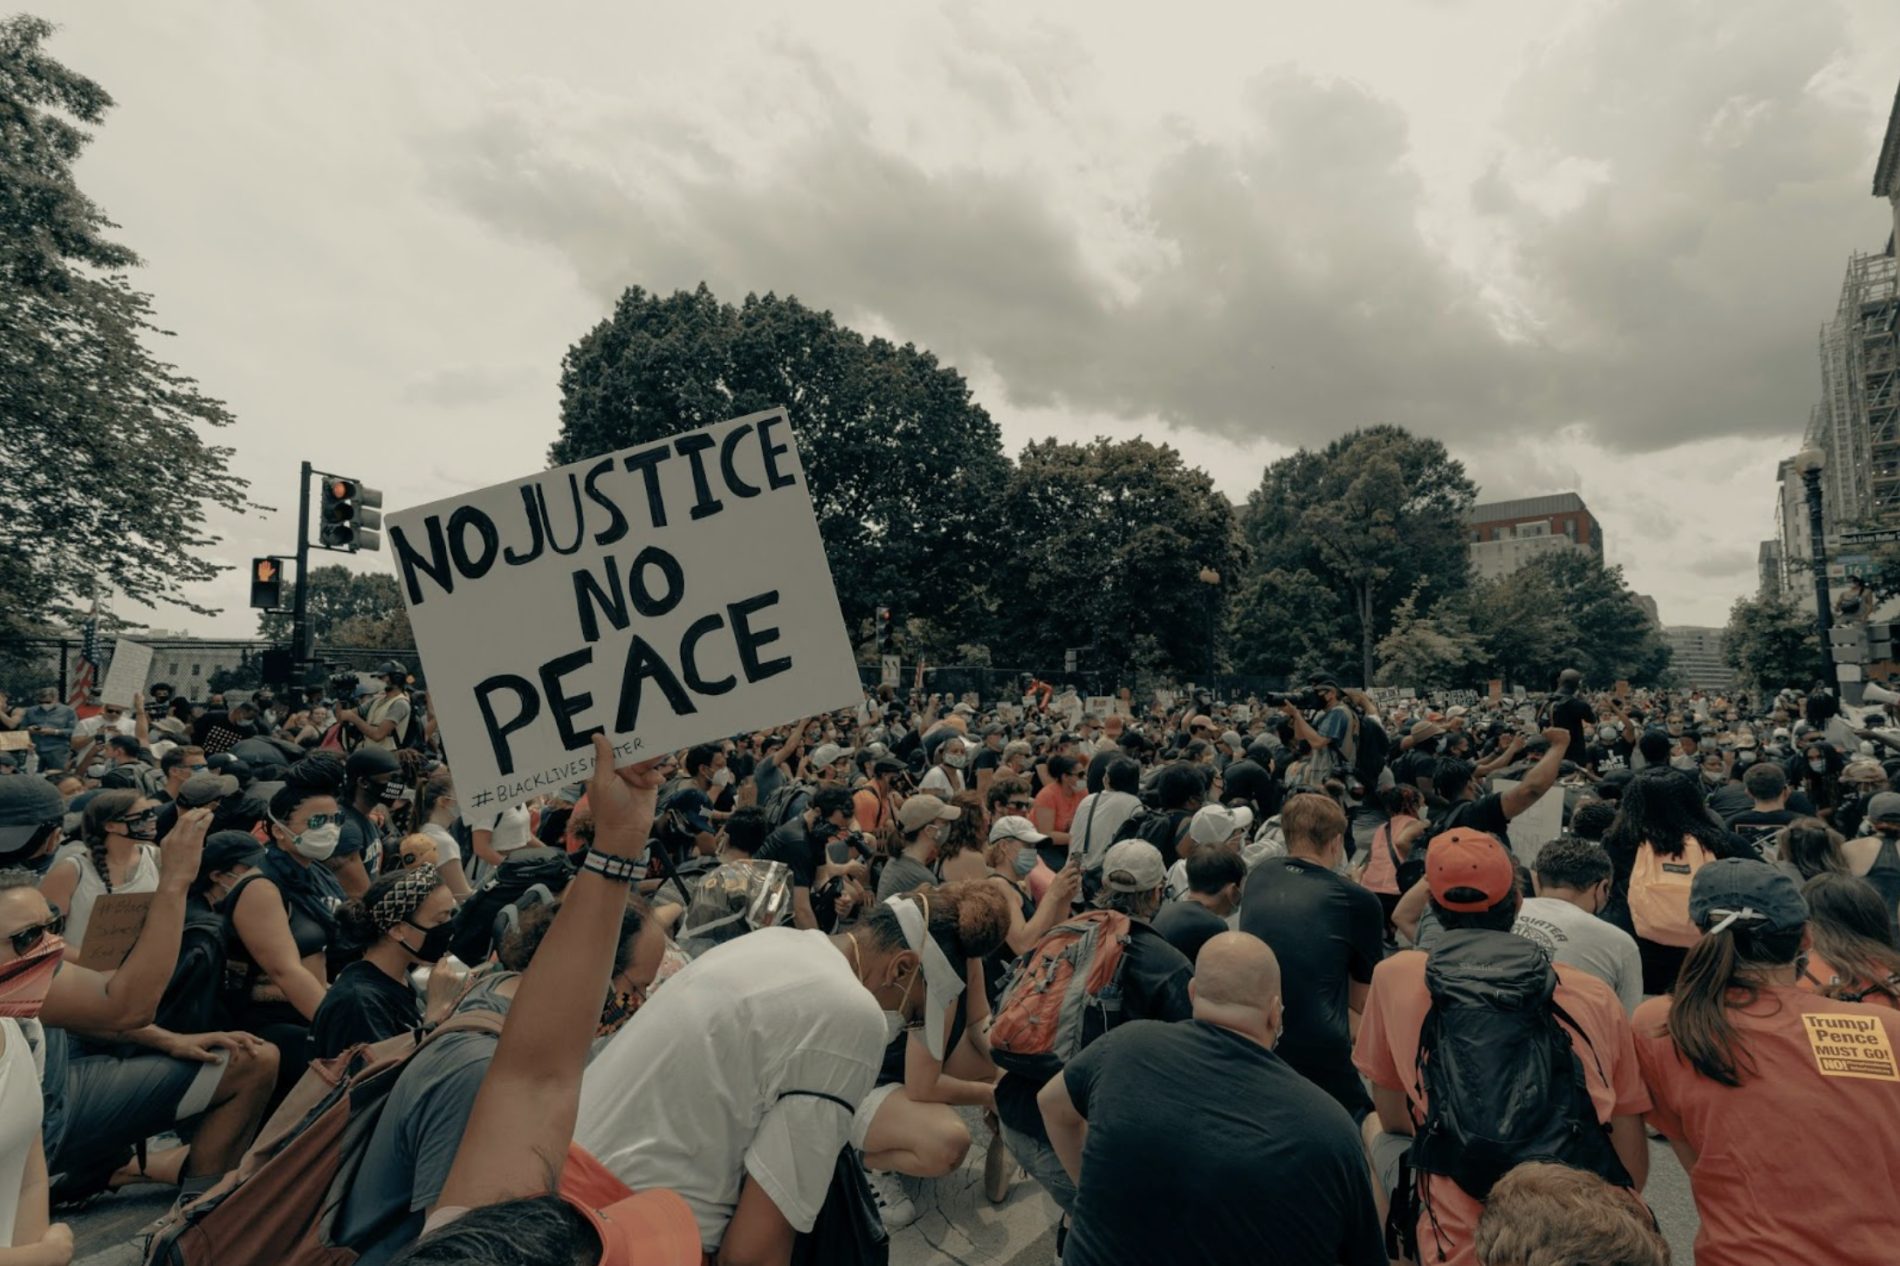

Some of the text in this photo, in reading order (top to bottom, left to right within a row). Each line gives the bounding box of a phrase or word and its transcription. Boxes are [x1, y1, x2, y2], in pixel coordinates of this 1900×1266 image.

[389, 415, 796, 605] NO JUSTICE
[572, 546, 685, 642] NO
[473, 589, 792, 776] PEACE
[471, 737, 645, 808] #BLACKLIVESTER
[1805, 1016, 1875, 1032] Trump/
[1815, 1029, 1879, 1045] Pence
[1815, 1045, 1890, 1060] MUST GO!
[1822, 1059, 1848, 1071] NO!
